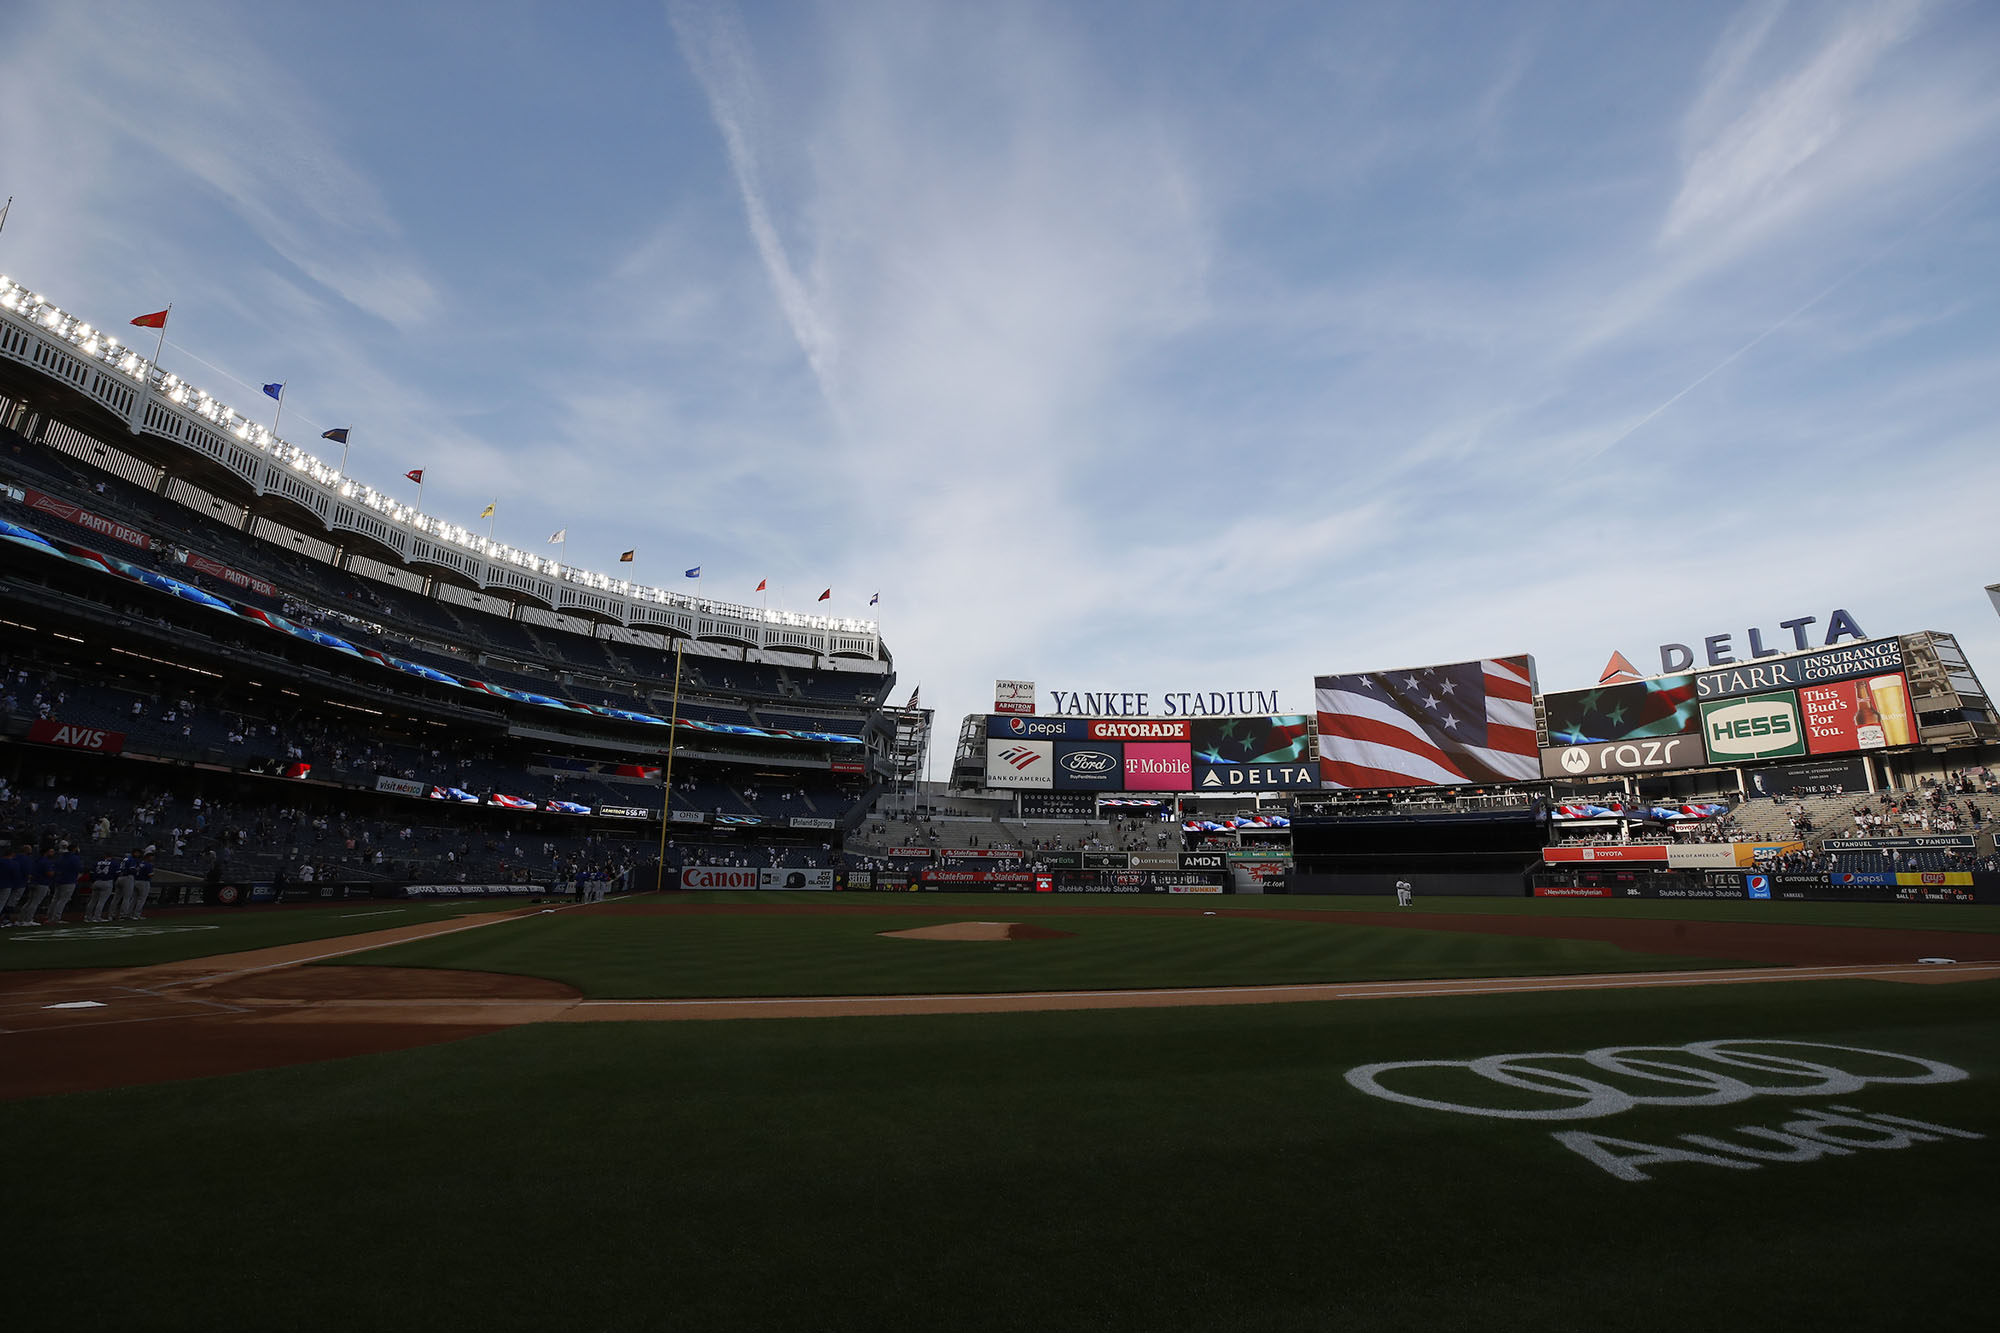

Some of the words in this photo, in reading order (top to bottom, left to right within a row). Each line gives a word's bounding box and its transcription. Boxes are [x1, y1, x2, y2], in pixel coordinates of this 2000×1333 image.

[79, 512, 115, 536] PARTY
[115, 527, 145, 546] DECK
[225, 569, 250, 587] PARTY
[251, 579, 272, 595] DECK
[1660, 608, 1867, 675] DELTA
[1804, 641, 1899, 668] INSURANCE
[1805, 652, 1902, 681] COMPANIES
[1697, 664, 1795, 697] STARR
[1804, 688, 1838, 702] This
[1050, 691, 1149, 716] YANKEE
[1163, 690, 1279, 716] STADIUM
[1807, 700, 1848, 714] Bud's
[1712, 713, 1791, 742] HESS
[1808, 715, 1834, 726] For
[1029, 722, 1066, 736] pepsi
[1095, 723, 1184, 737] GATORADE
[1810, 727, 1844, 738] You.
[51, 726, 104, 748] AVIS
[1600, 739, 1680, 769] razr
[1070, 753, 1105, 771] Ford
[1140, 759, 1190, 774] Mobile
[1230, 768, 1312, 785] DELTA
[380, 780, 396, 790] visit
[792, 819, 815, 827] Poland
[816, 820, 833, 829] Spring
[1926, 838, 1961, 846] FANDUEL
[1184, 857, 1212, 866] AMD
[683, 868, 756, 888] Canon
[848, 876, 871, 884] SELTZER
[1857, 875, 1884, 884] pepsi
[1058, 885, 1084, 893] StubHub
[1085, 885, 1112, 893] StubHub
[1113, 885, 1140, 893] StubHub
[1659, 889, 1686, 897] StubHub
[1687, 889, 1714, 897] StubHub
[1715, 889, 1742, 897] StubHub
[1551, 1105, 1987, 1181] Audi
